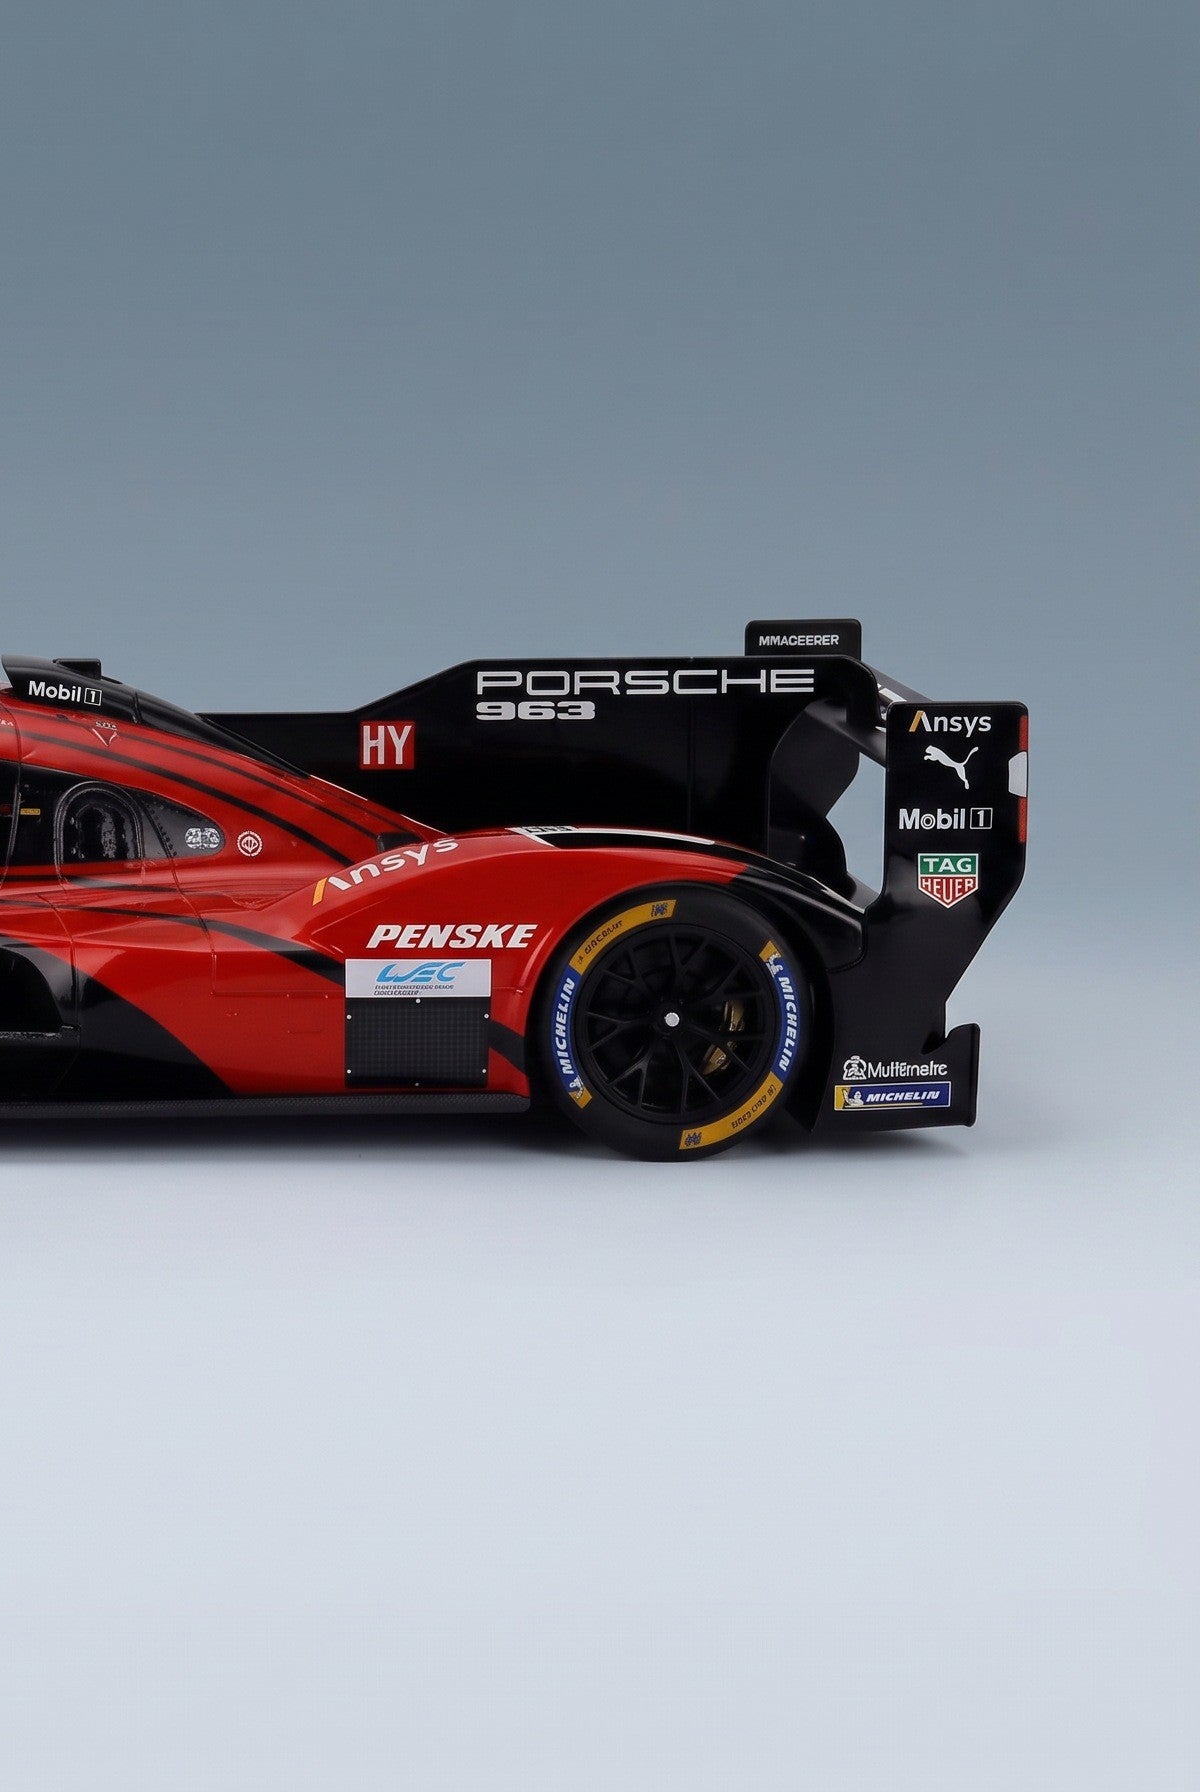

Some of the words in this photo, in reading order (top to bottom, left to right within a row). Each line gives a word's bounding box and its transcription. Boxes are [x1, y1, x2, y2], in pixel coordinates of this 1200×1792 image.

[28, 680, 82, 703] Mobil
[476, 669, 815, 696] PORSCHE
[476, 701, 596, 720] 963
[908, 710, 992, 738] Ansys
[362, 725, 412, 765] HY
[898, 808, 966, 830] Mobil
[312, 836, 460, 906] Ansys
[923, 857, 972, 873] TAG
[921, 876, 975, 904] HEUER
[365, 924, 539, 949] PENSKE
[555, 976, 577, 1075] MICHELIN
[778, 976, 798, 1072] MICHELIN
[865, 1090, 940, 1103] MICHELIN
